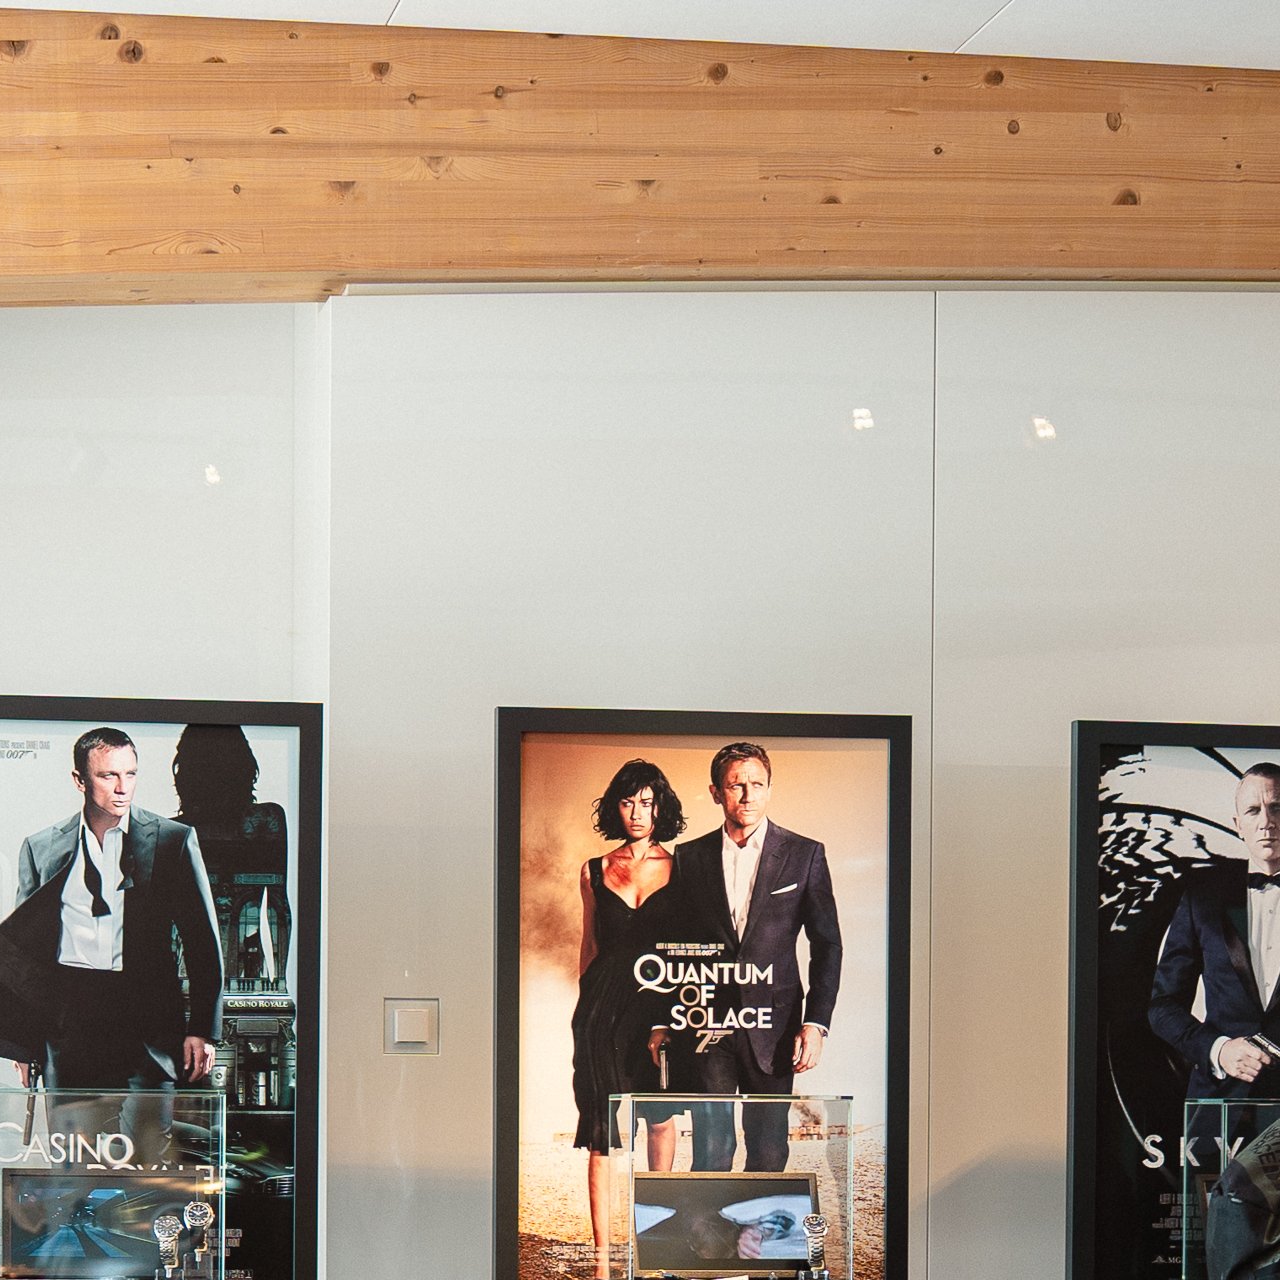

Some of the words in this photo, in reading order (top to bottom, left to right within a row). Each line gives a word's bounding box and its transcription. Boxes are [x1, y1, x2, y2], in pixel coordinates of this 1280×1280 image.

[6, 750, 28, 759] 007
[633, 953, 774, 994] QUANTUM
[679, 984, 716, 1006] OF
[227, 1000, 258, 1008] CASINO
[258, 1000, 289, 1008] ROYALE
[669, 1004, 773, 1031] SOLACE
[1168, 1256, 1184, 1264] MG
